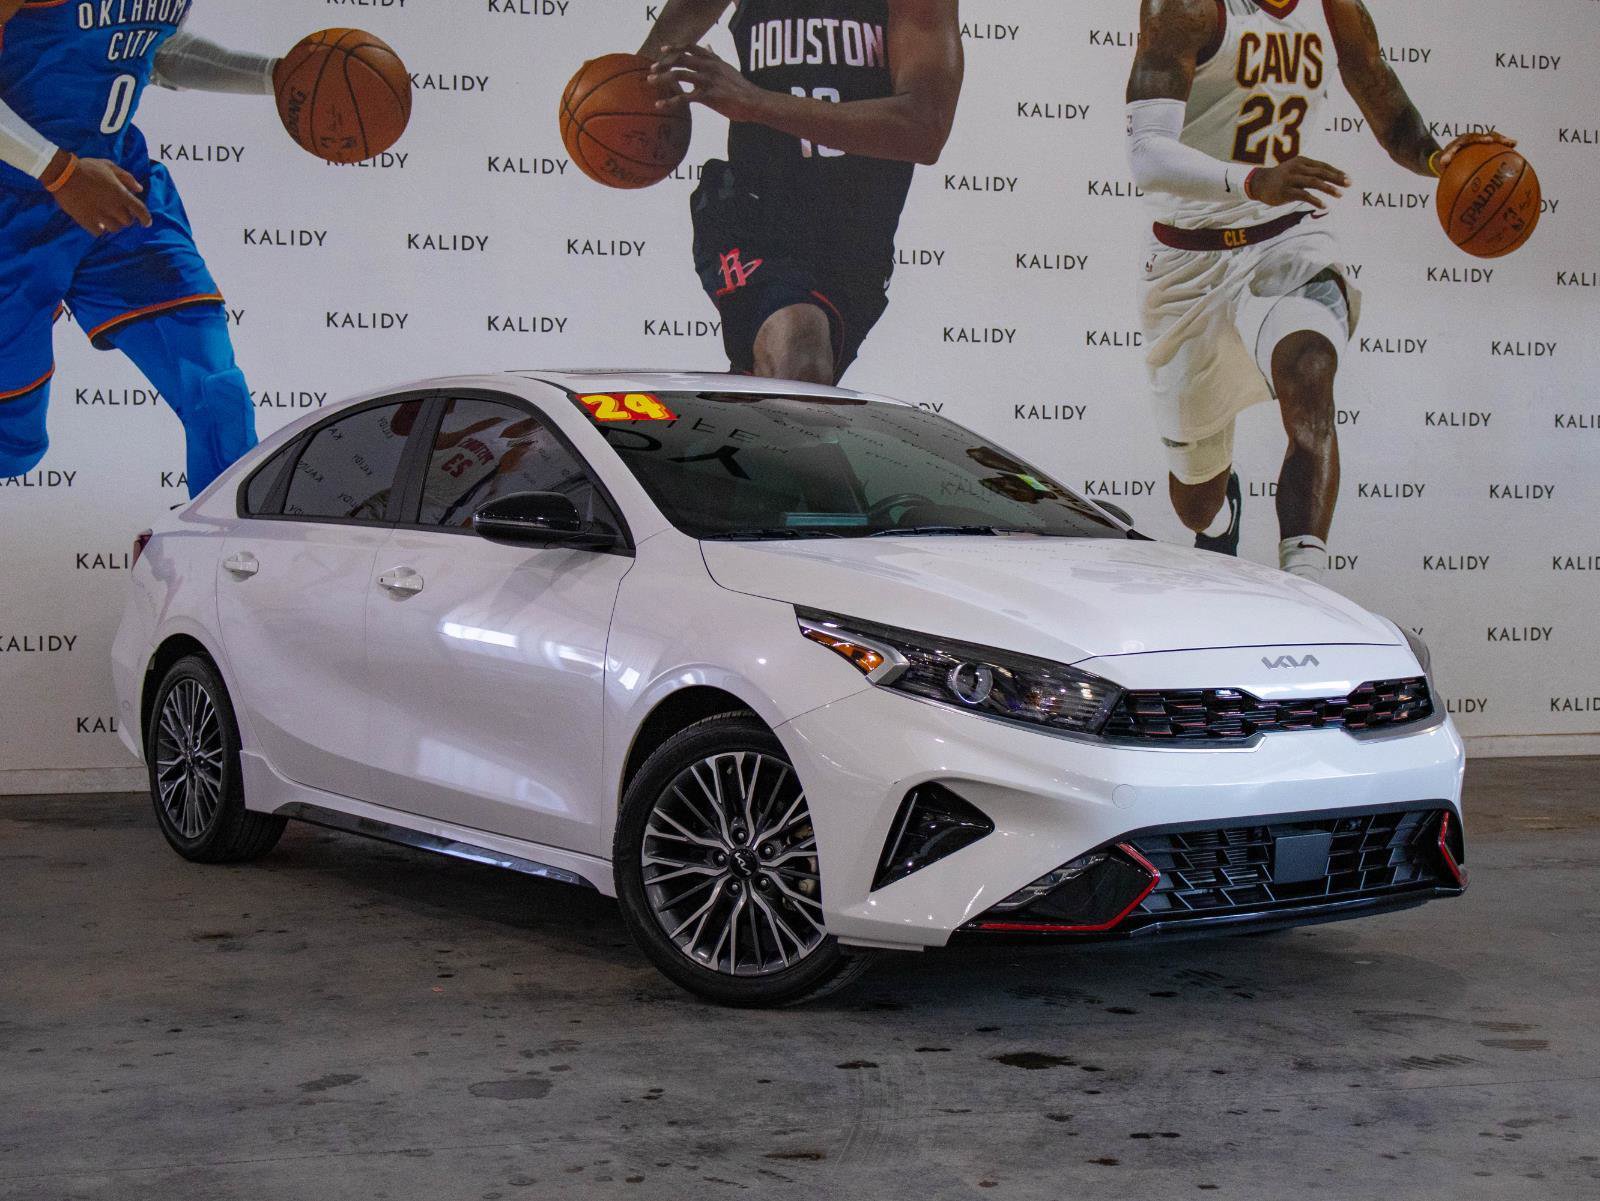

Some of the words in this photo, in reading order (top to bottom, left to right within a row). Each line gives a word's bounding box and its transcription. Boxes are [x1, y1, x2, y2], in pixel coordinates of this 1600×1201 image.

[488, 0, 569, 16] KALIDY
[960, 23, 1019, 41] ALIDY
[1089, 30, 1140, 47] KALI
[107, 30, 158, 60] CITY
[750, 17, 884, 71] HOUSTON
[1236, 32, 1324, 90] CAVS
[1380, 47, 1431, 64] ALIDY
[1495, 53, 1561, 70] KALIDY
[409, 73, 489, 92] KALIDY
[101, 75, 136, 135] 0
[1018, 102, 1090, 120] KALIDY
[1232, 93, 1308, 165] 23
[1325, 117, 1364, 133] IDY
[1559, 128, 1600, 144] KALI
[160, 143, 246, 163] KALIDY
[488, 156, 569, 175] KALIDY
[944, 174, 1018, 192] KALIDY
[1362, 192, 1430, 209] KALIDY
[243, 228, 328, 247] KALIDY
[407, 233, 489, 252] KALIDY
[1223, 228, 1248, 247] CLE
[567, 239, 646, 257] KALIDY
[893, 250, 945, 266] LIDY
[1016, 253, 1088, 270] KALIDY
[1427, 267, 1494, 283] KALIDY
[1557, 271, 1600, 287] KALI
[326, 311, 408, 330] KALIDY
[487, 315, 568, 333] KALIDY
[643, 319, 721, 337] KALIDY
[943, 326, 1016, 344] KALIDY
[1086, 331, 1142, 347] KALID
[1359, 337, 1427, 354] KALIDY
[1491, 341, 1557, 357] KALIDY
[75, 388, 161, 406] KALIDY
[581, 394, 671, 420] 24
[1014, 404, 1087, 421] KALIDY
[1425, 411, 1491, 428] KALIDY
[1555, 414, 1600, 430] KALI
[0, 470, 77, 488] ALIDY
[1084, 480, 1156, 497] KALIDY
[1357, 483, 1426, 498] KALIDY
[1489, 485, 1555, 499] KALIDY
[76, 553, 129, 570] KALI
[1326, 556, 1358, 570] IDY
[1422, 556, 1490, 571] KALIDY
[1487, 627, 1553, 642] KALIDY
[1446, 698, 1488, 714] LIDY
[1550, 697, 1600, 713] KALID
[76, 716, 117, 734] KAL
